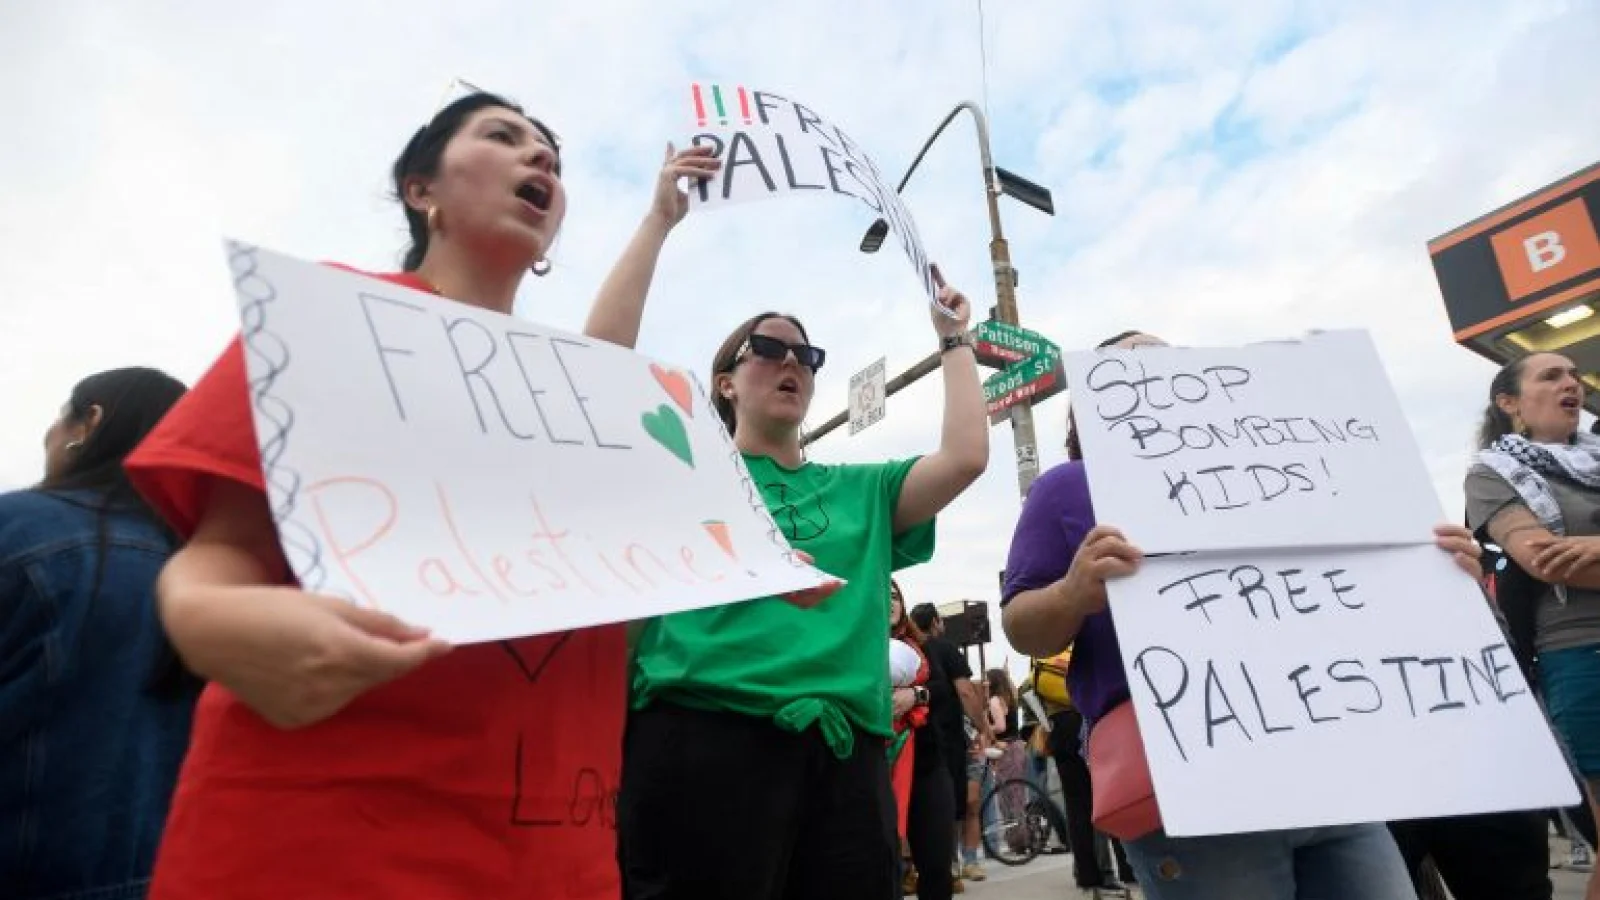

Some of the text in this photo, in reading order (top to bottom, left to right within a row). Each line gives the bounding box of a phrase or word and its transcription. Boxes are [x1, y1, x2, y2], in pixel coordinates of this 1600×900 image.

[1523, 230, 1566, 272] B
[977, 322, 1041, 354] Pattison
[357, 291, 633, 450] FREE
[1034, 356, 1052, 375] St
[1107, 415, 1380, 459] BOMBING
[1163, 457, 1338, 515] KIDS!
[1157, 565, 1366, 624] FREE
[1133, 643, 1527, 762] PALESTINE
